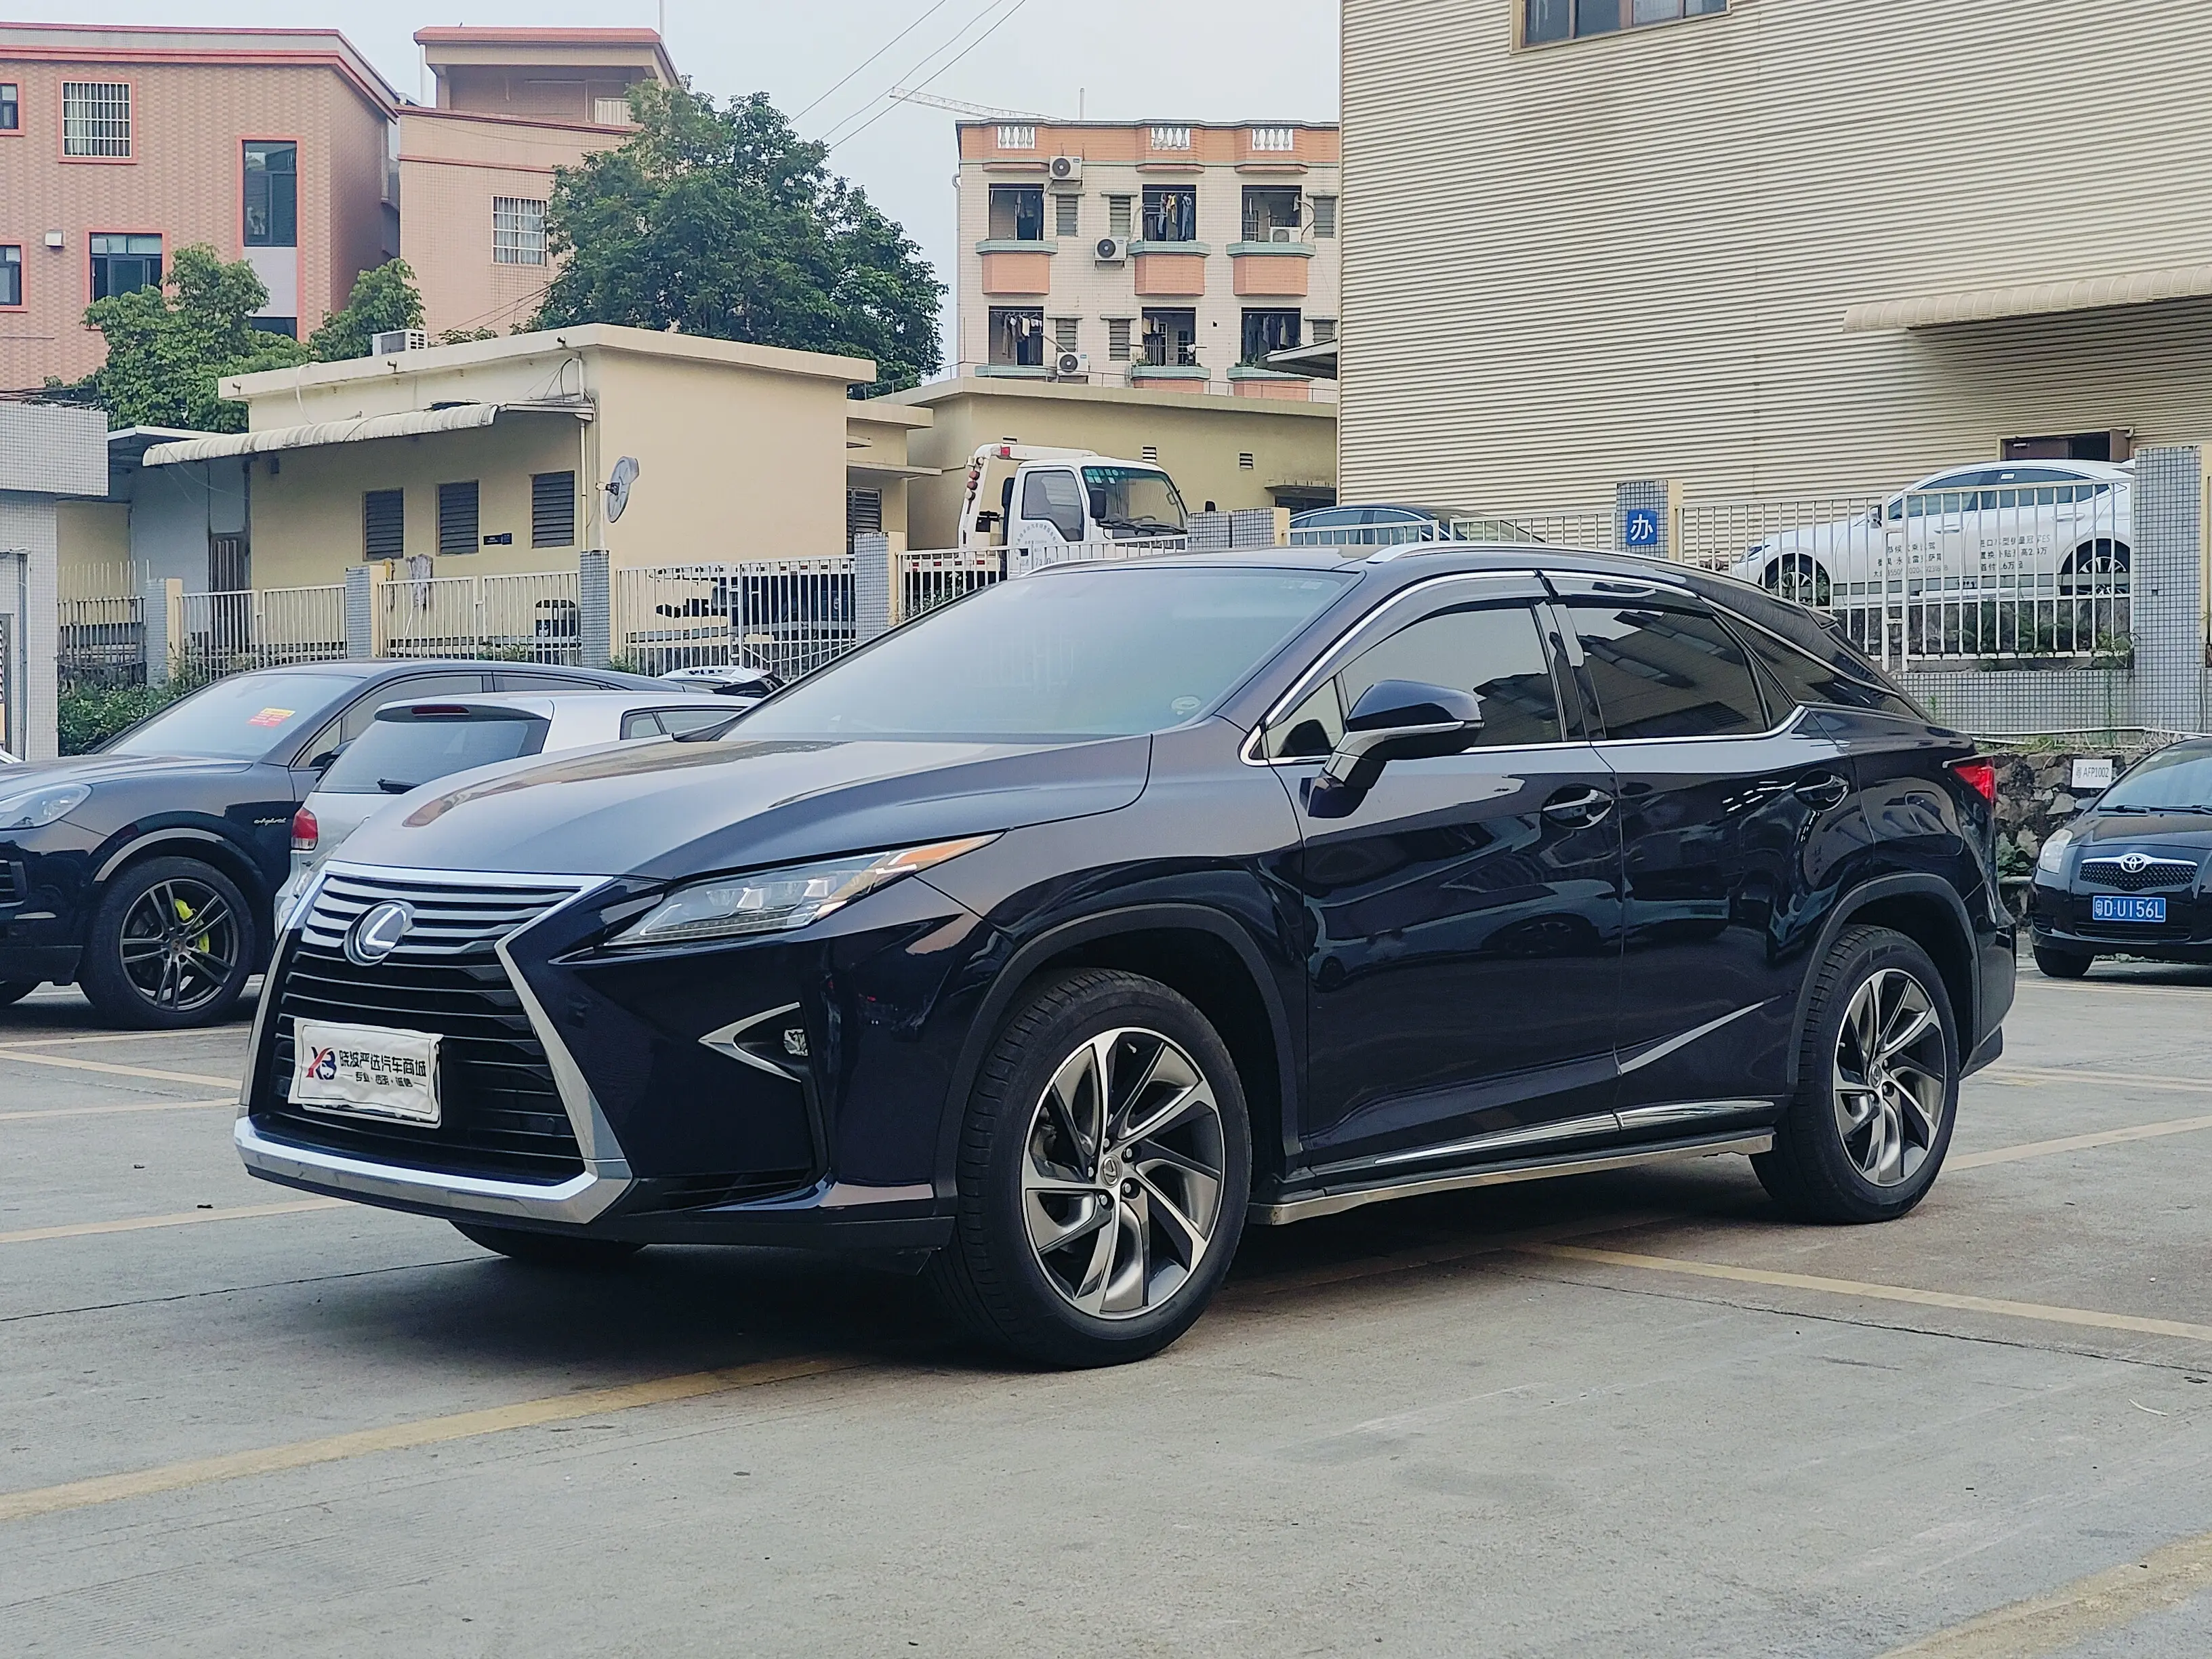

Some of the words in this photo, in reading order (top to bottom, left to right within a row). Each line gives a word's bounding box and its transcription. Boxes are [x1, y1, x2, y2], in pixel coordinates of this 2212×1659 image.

[1630, 514, 1654, 541] 办
[339, 1050, 426, 1077] 晓波严选汽车商城
